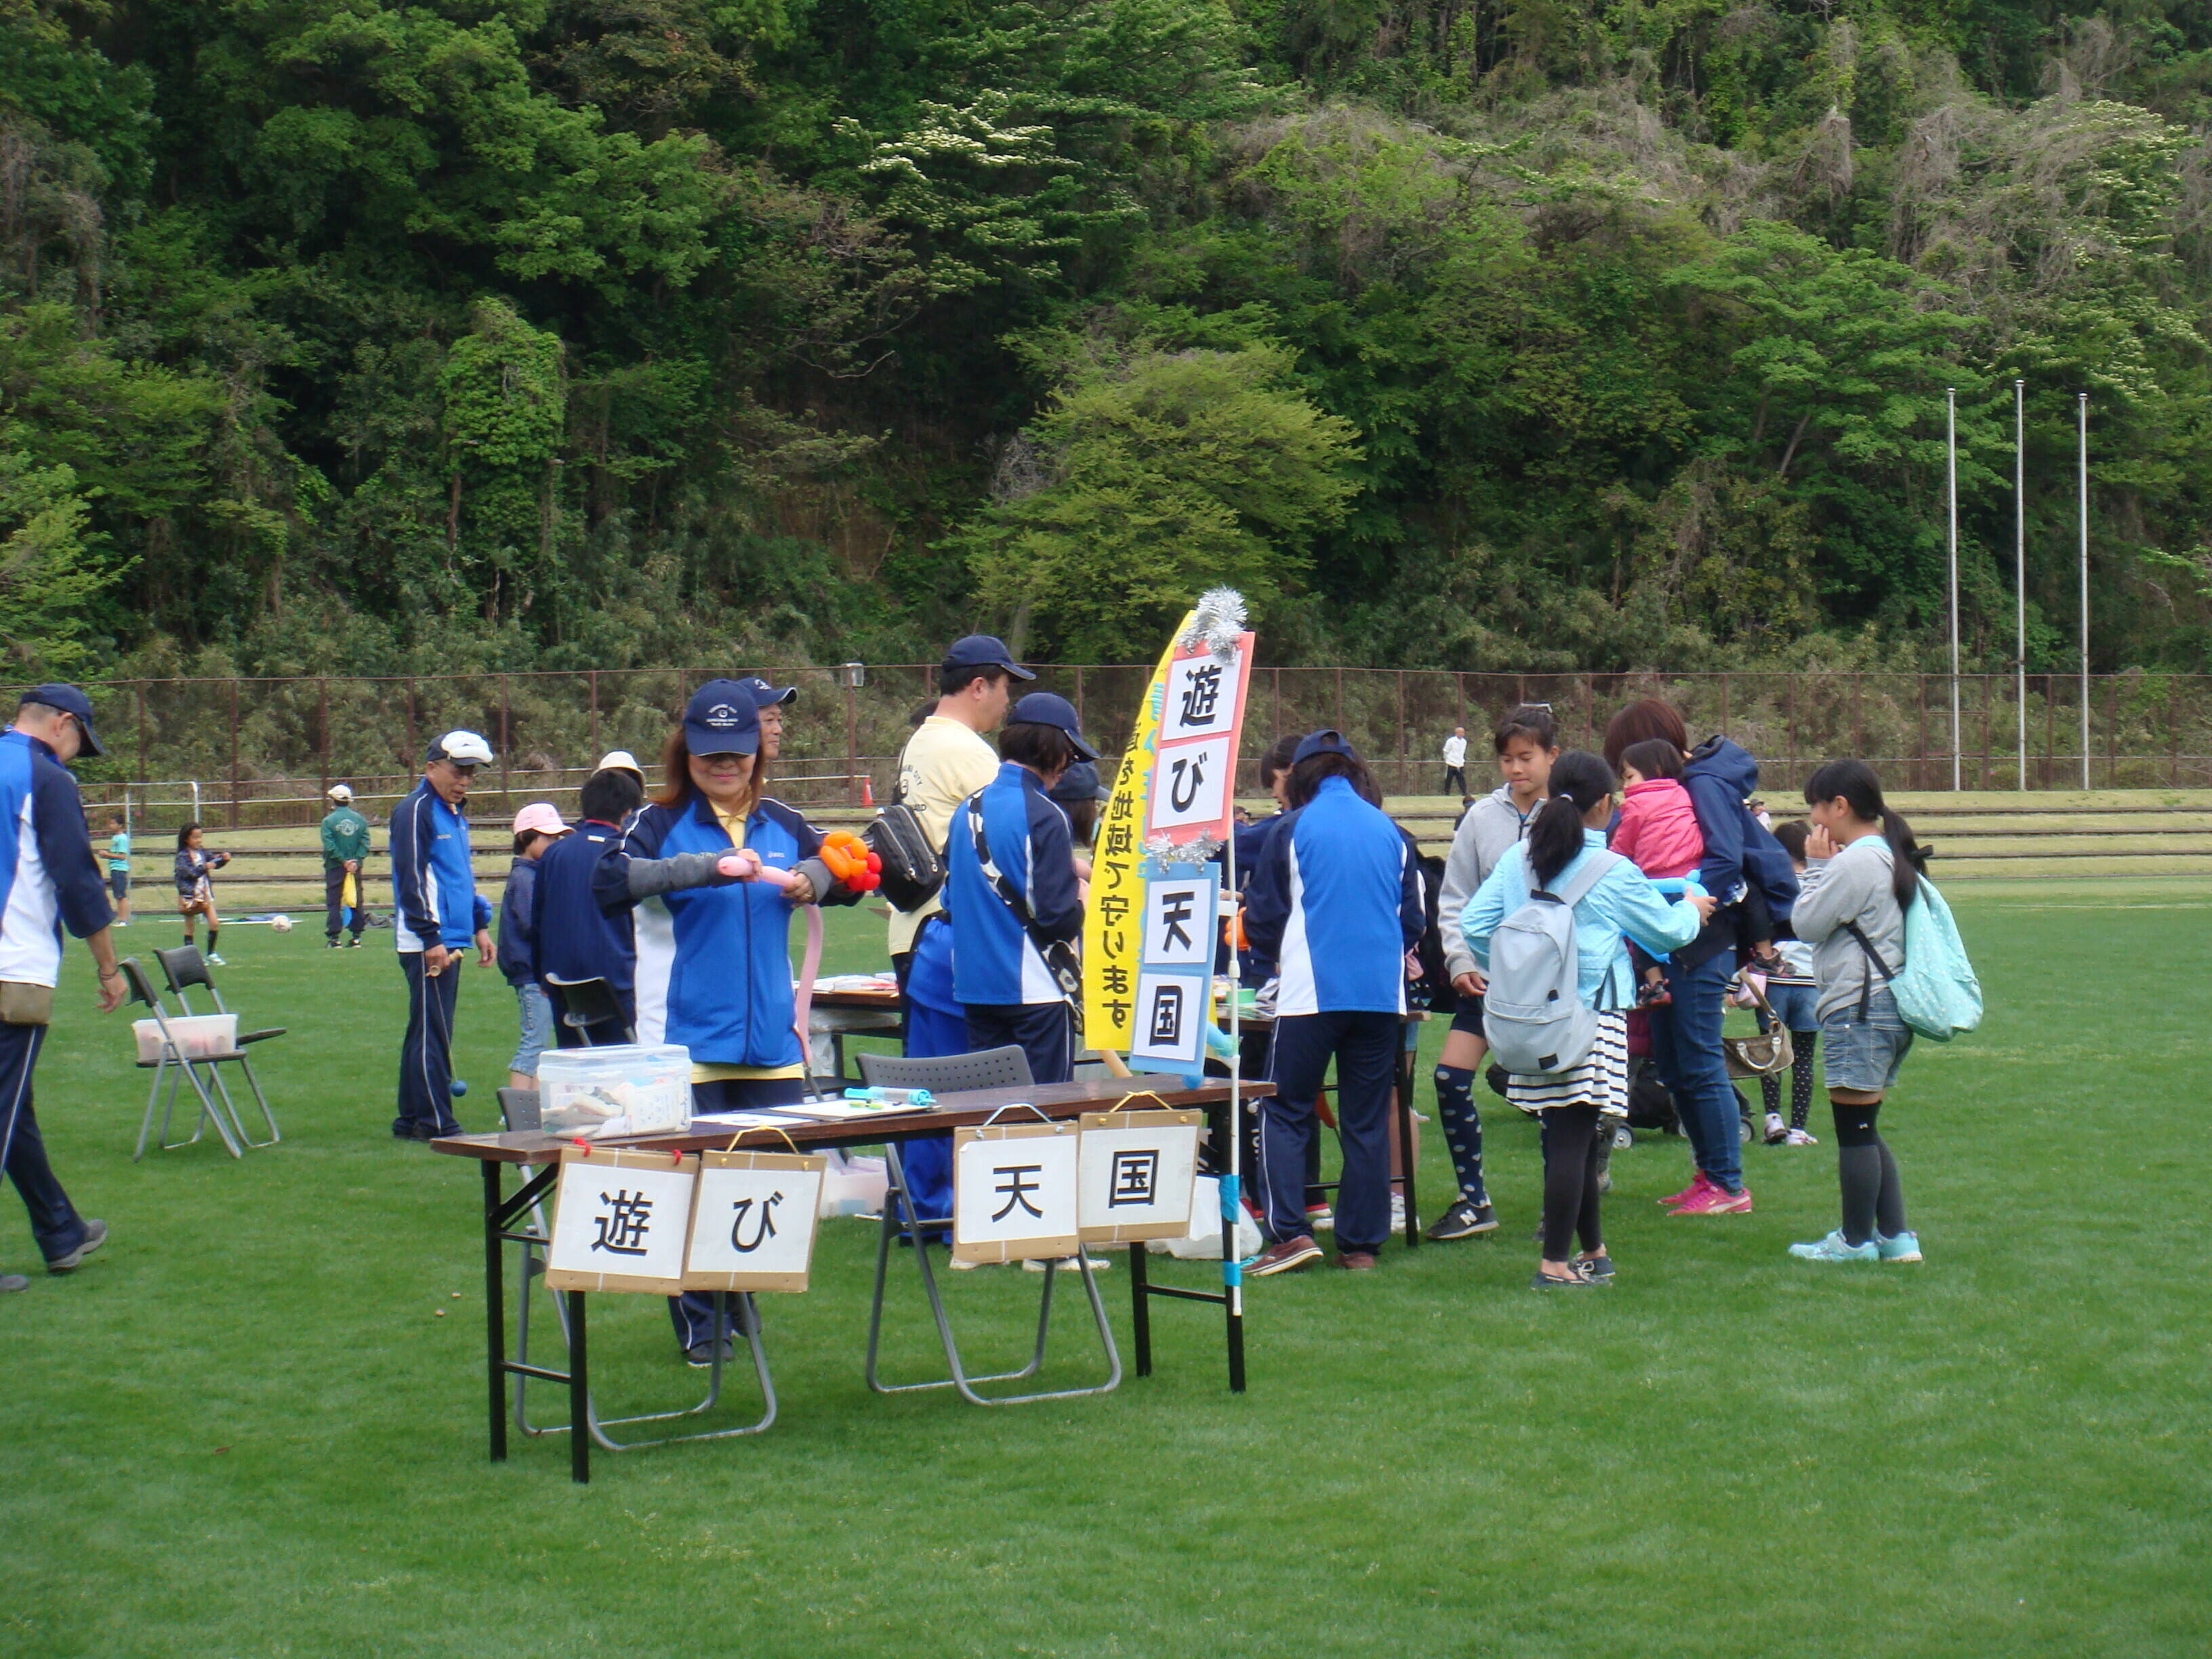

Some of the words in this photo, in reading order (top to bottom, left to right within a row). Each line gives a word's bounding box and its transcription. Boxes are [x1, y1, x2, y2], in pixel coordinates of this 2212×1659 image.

[1171, 664, 1222, 813] 遊び
[1149, 891, 1195, 1046] 天国
[590, 1189, 783, 1256] 遊び
[991, 1149, 1160, 1223] 天国
[1460, 1209, 1477, 1226] N
